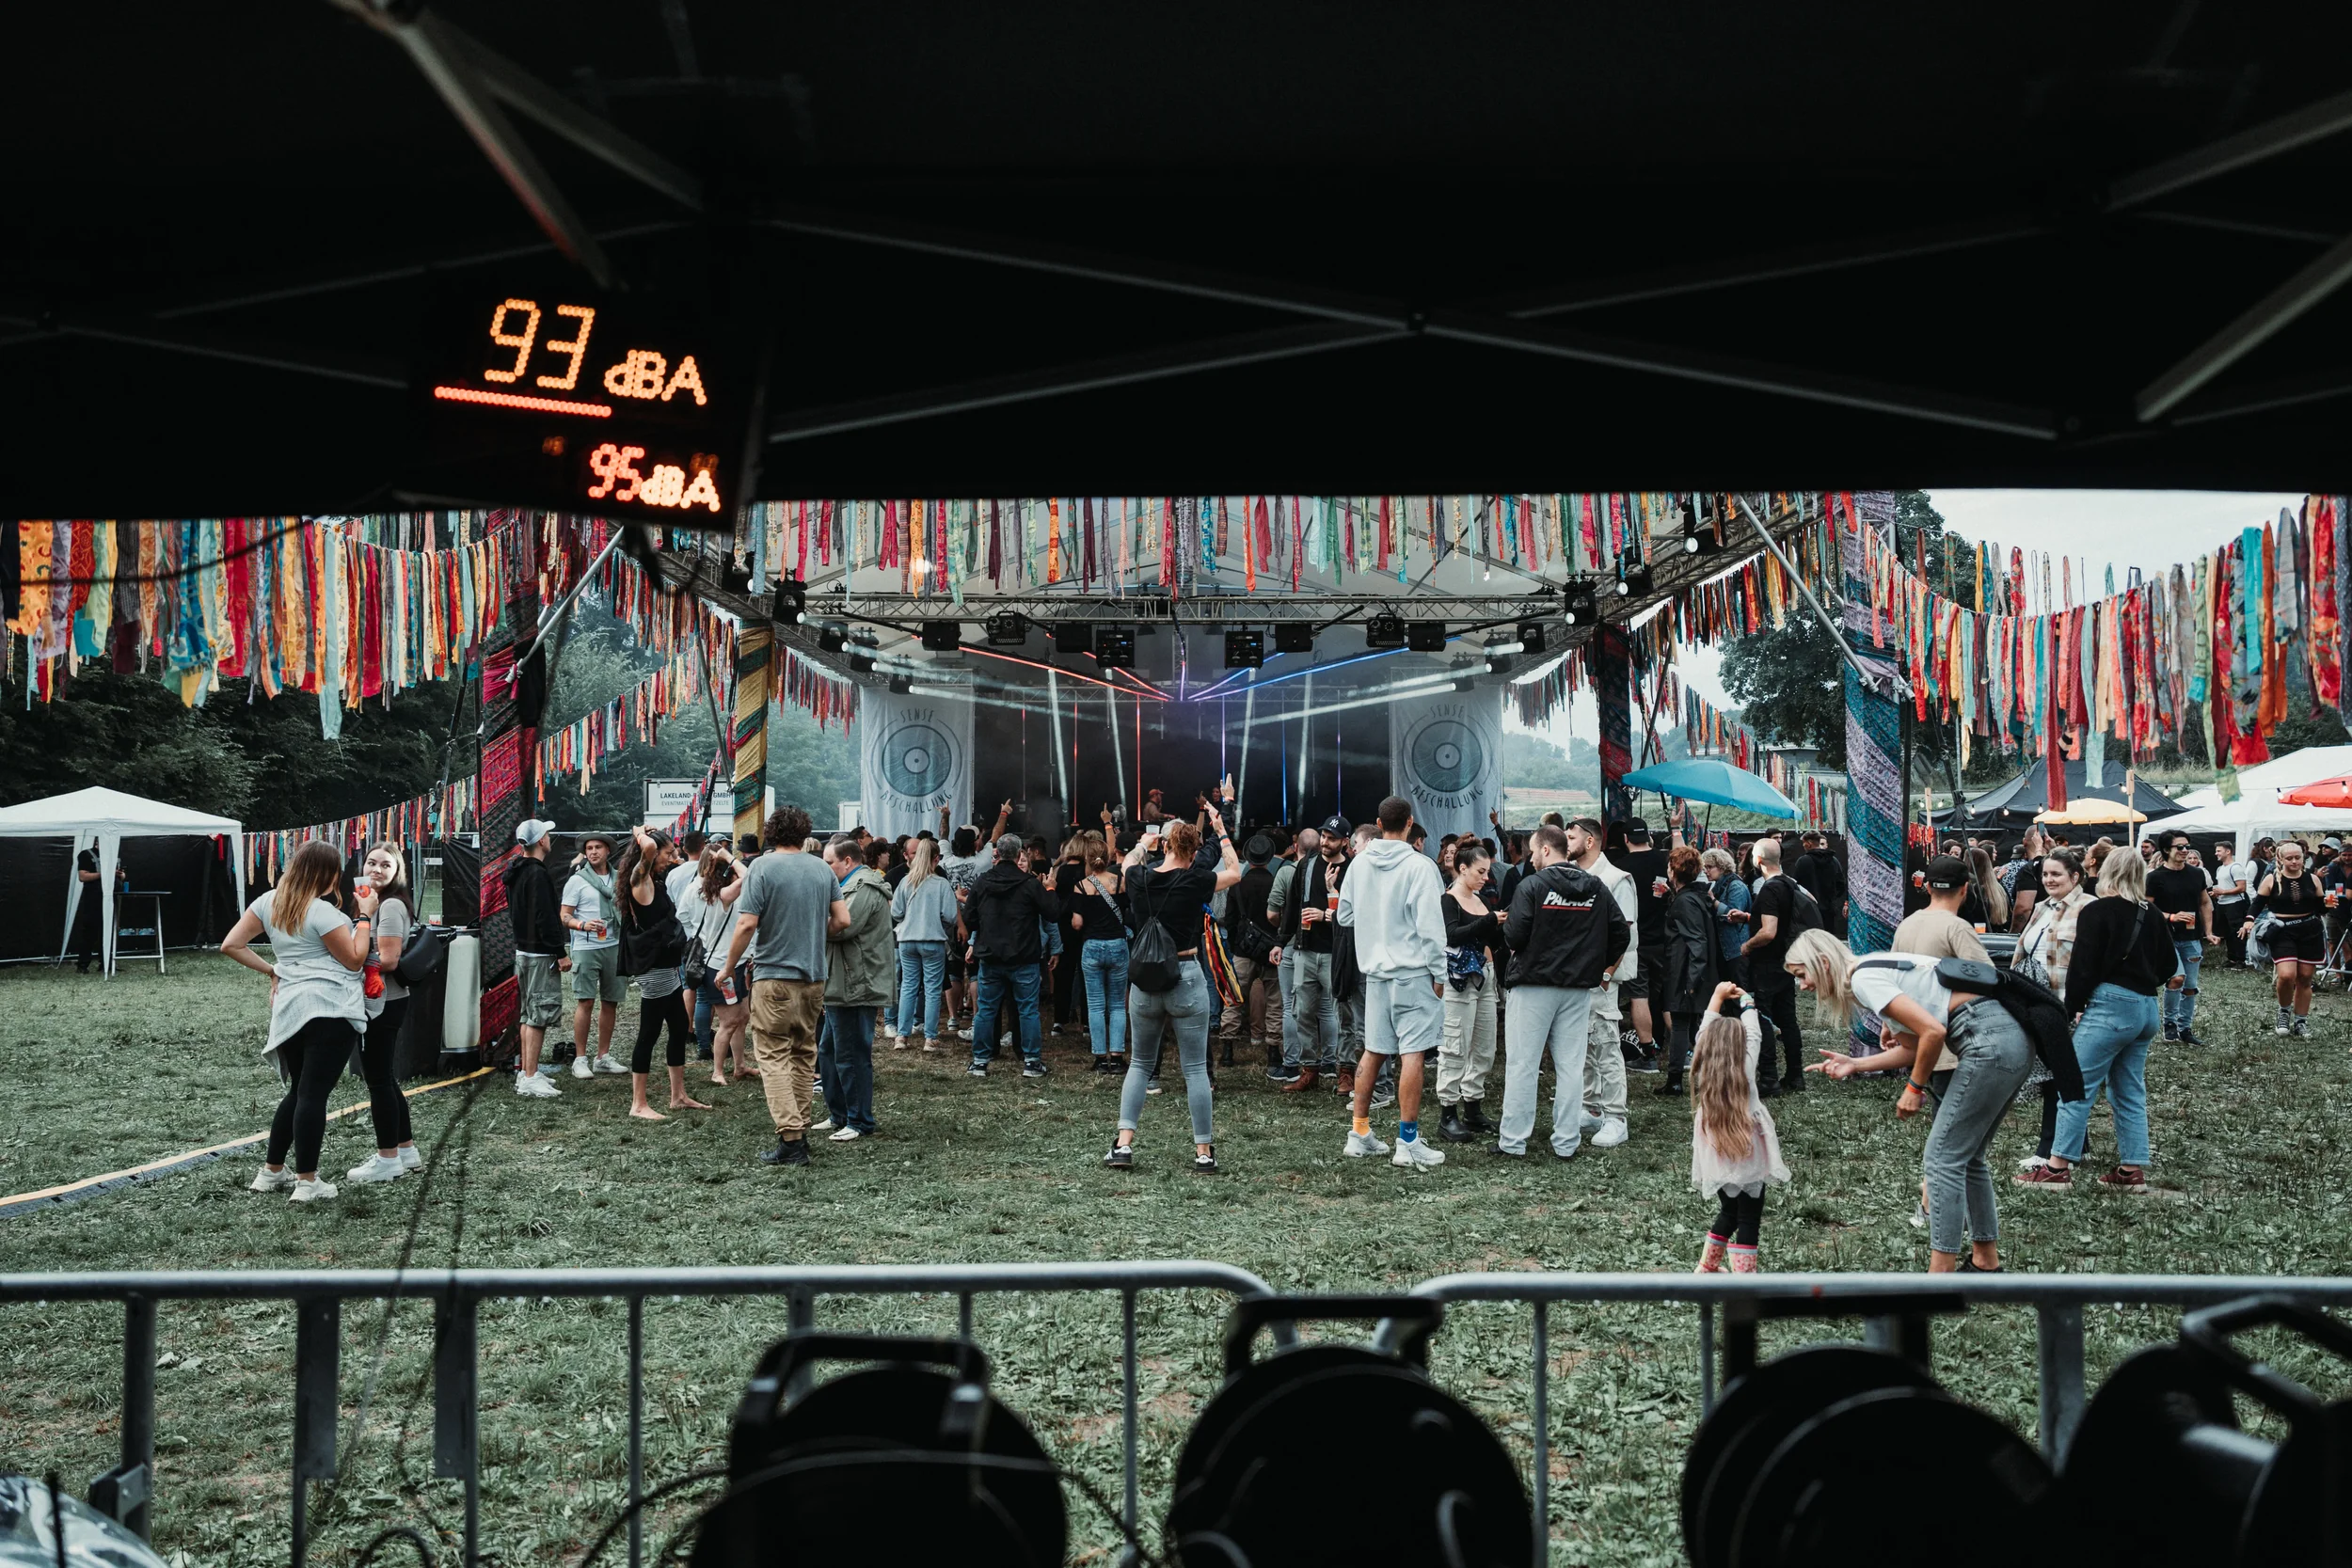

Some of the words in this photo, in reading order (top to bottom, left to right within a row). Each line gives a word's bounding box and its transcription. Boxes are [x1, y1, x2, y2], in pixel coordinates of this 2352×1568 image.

[484, 297, 596, 390] 93
[603, 349, 707, 405] dBA
[900, 707, 935, 723] SENSE
[1430, 704, 1465, 718] SENSE
[880, 789, 952, 814] BESCHALLUNG
[1410, 784, 1484, 809] BESCHALLUNG
